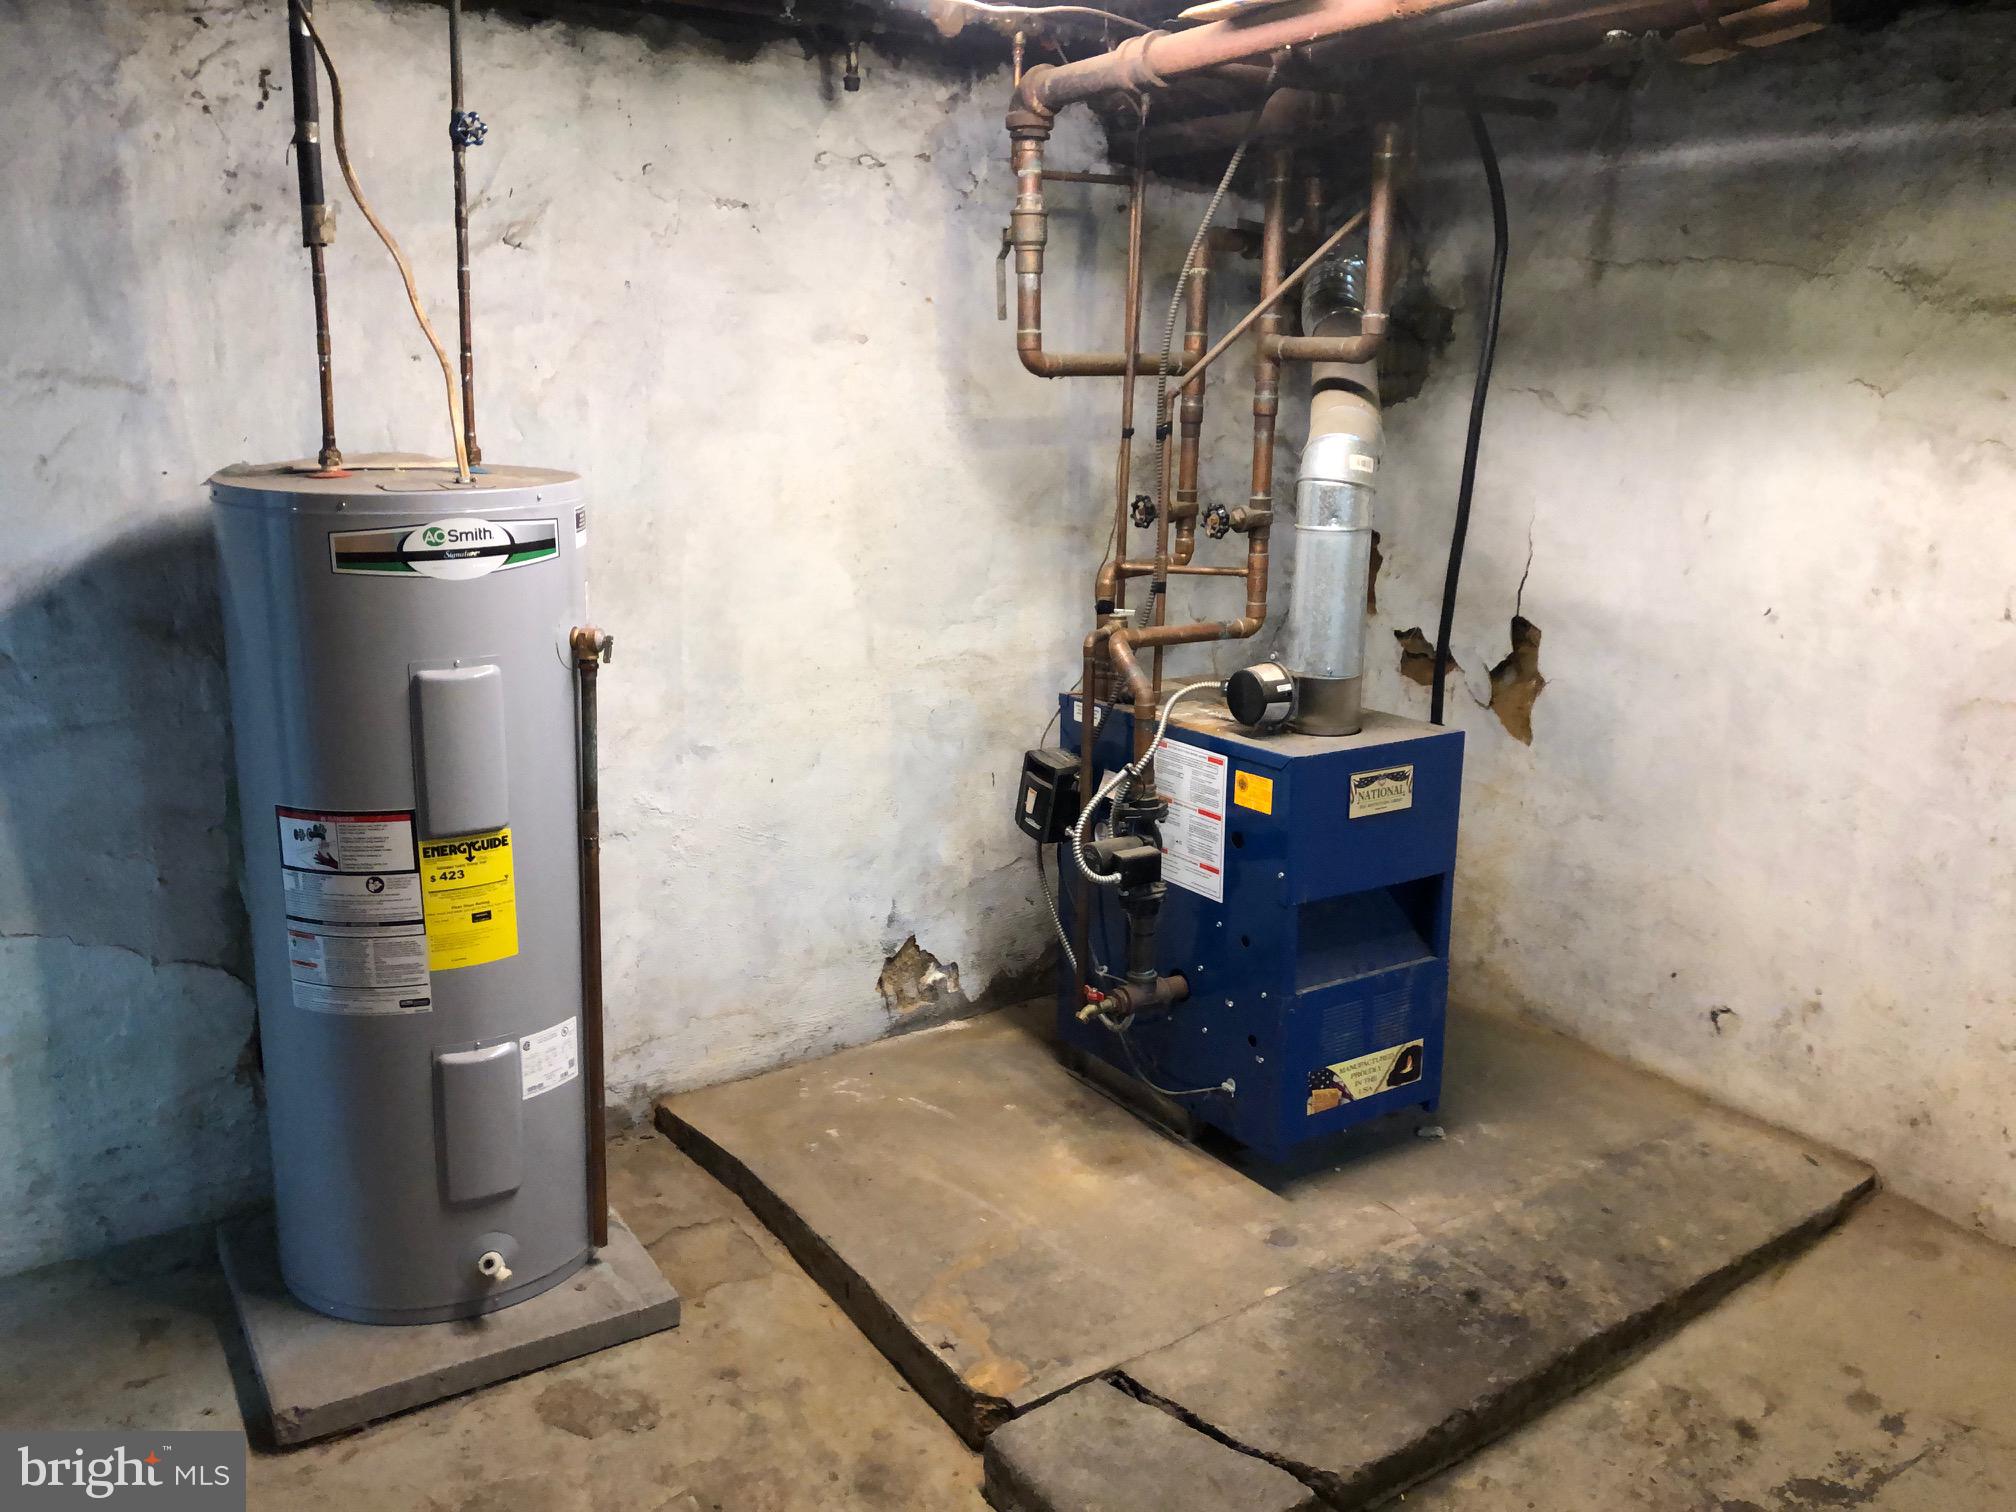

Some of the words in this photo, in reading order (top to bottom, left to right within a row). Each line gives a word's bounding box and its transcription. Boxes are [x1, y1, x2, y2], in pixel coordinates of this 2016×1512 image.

[424, 529, 446, 545] AO
[448, 528, 492, 543] Smith
[1358, 784, 1404, 800] NATIONAL
[439, 870, 465, 881] 423
